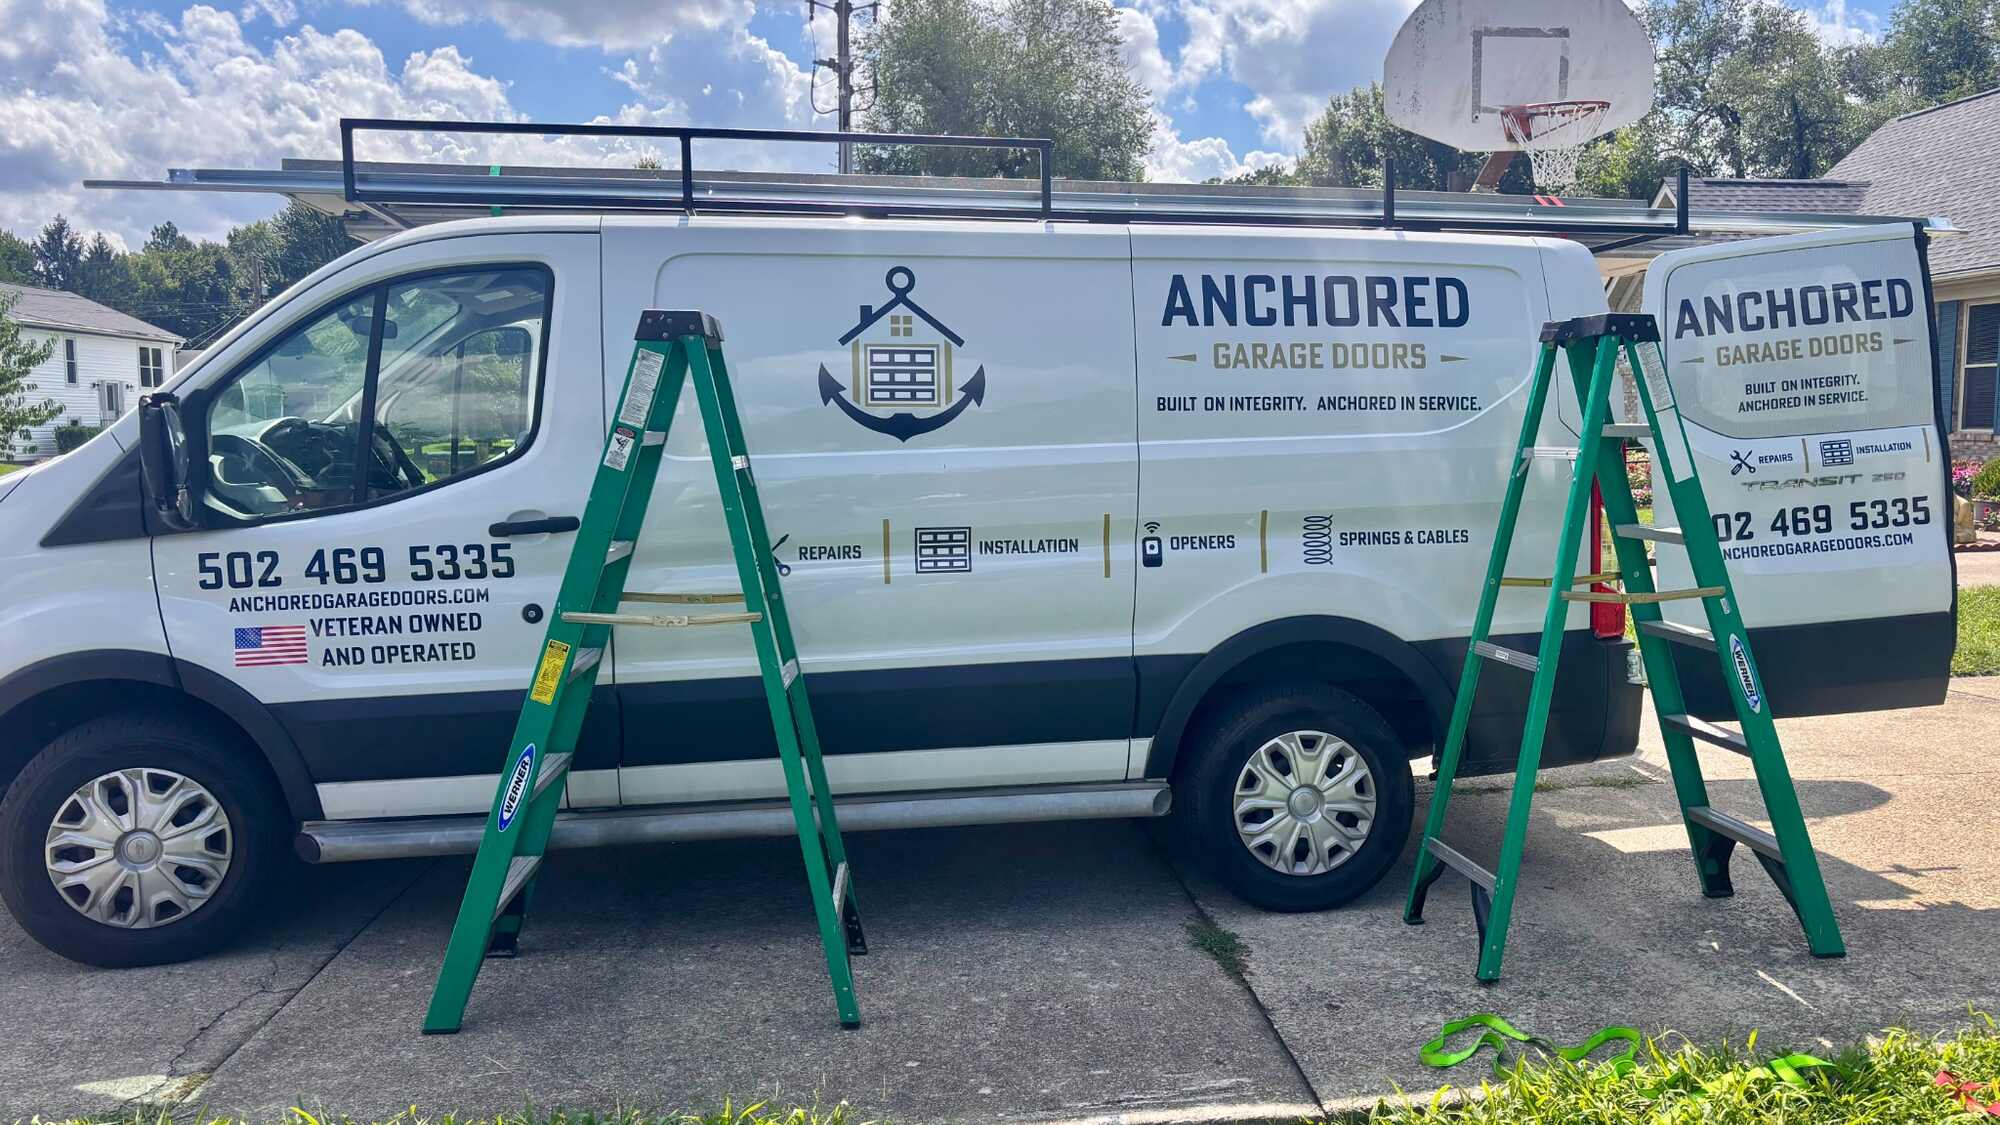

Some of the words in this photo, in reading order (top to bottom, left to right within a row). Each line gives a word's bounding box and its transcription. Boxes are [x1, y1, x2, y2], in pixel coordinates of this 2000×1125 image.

[1161, 274, 1470, 328] ANCHORED
[1675, 278, 1914, 340] ANCHORED
[1213, 342, 1323, 370] GARAGE
[1331, 343, 1427, 370] DOORS
[1716, 339, 1804, 367] GARAGE
[1808, 331, 1883, 358] DOORS
[1745, 380, 1777, 395] BUILT
[1781, 378, 1798, 392] ON
[1800, 374, 1860, 391] INTEGRITY.
[1157, 396, 1197, 412] BUILT
[1204, 396, 1225, 412] ON
[1229, 396, 1307, 412] INTEGRITY.
[1317, 396, 1396, 411] ANCHORED
[1400, 396, 1415, 411] IN
[1418, 396, 1482, 411] SERVICE.
[1738, 395, 1801, 414] ANCHORED
[1804, 394, 1816, 407] IN
[1818, 390, 1868, 406] SERVICE.
[1758, 452, 1793, 465] REPAIRS
[1855, 441, 1912, 455] INSTALLATION
[1741, 474, 1863, 492] TRANSIT
[1711, 511, 1754, 542] 02
[1770, 504, 1832, 537] 469
[1850, 496, 1930, 530] 5335
[979, 538, 1079, 554] INSTALLATION
[1170, 535, 1235, 550] OPENERS
[1339, 530, 1400, 546] SPRINGS
[1404, 529, 1413, 544] &
[1417, 529, 1469, 545] CABLES
[1722, 532, 1914, 561] NCHOREDGARAGEDOORS.COM
[799, 544, 862, 560] REPAIRS
[198, 550, 282, 590] 502
[304, 547, 387, 585] 469
[409, 543, 515, 582] 5335
[229, 588, 489, 613] ANCHOREDGARAGEDOORS.COM
[310, 616, 402, 637] VETERAN
[409, 612, 482, 634] OWNED
[322, 647, 365, 666] AND
[371, 642, 476, 664] OPERATED
[1735, 650, 1755, 698] WERNER
[505, 760, 529, 814] WERNER
